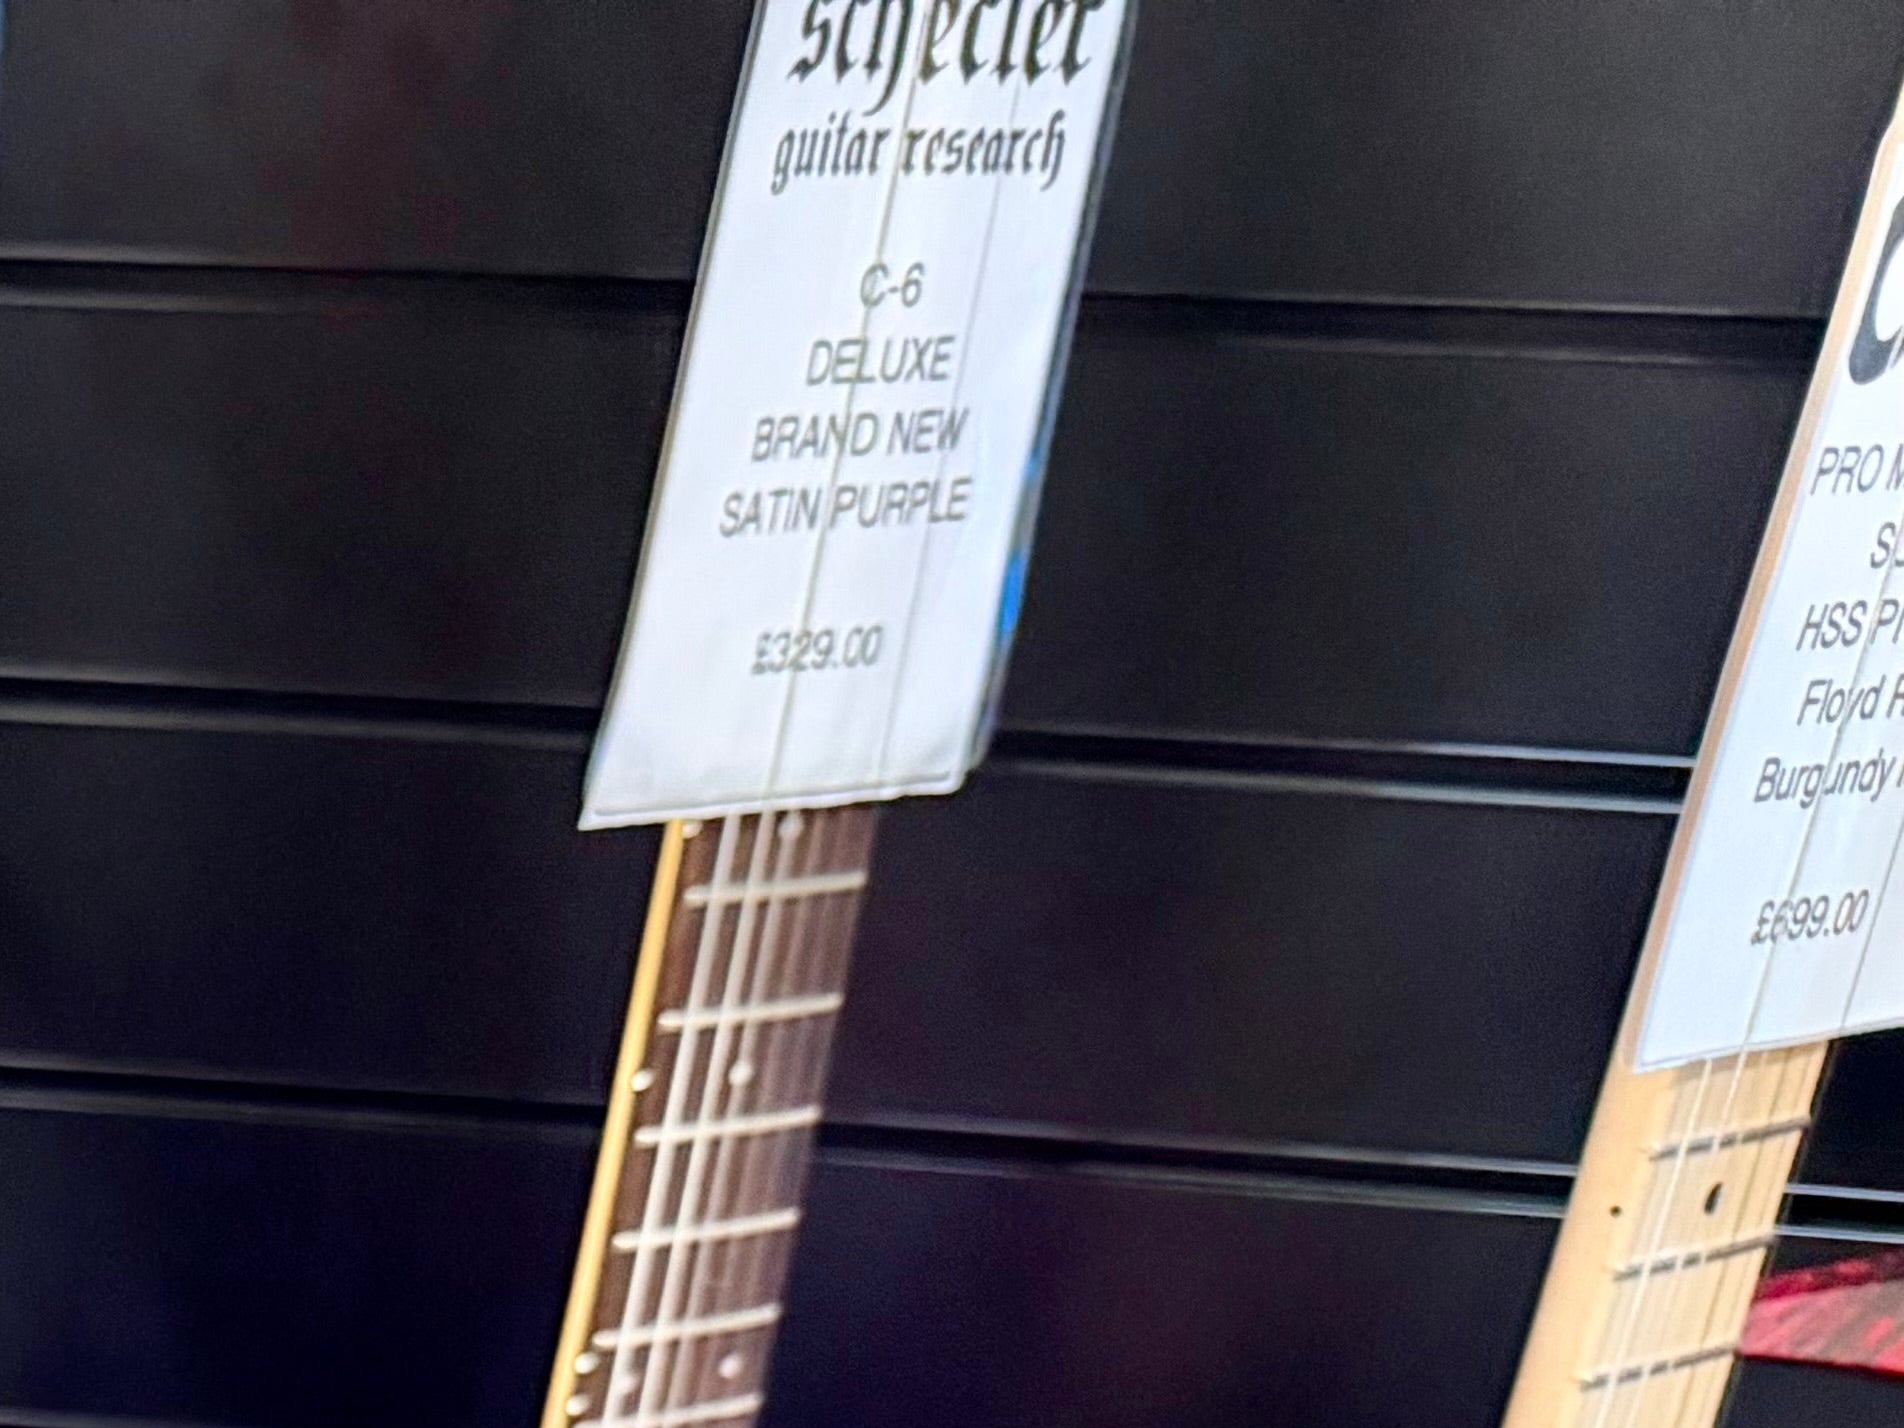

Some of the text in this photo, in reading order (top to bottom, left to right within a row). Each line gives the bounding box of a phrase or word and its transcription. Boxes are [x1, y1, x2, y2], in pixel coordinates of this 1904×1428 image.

[771, 109, 1066, 196] guitar research
[860, 262, 925, 309] C-6
[806, 335, 956, 387] DELUXE
[751, 408, 971, 464] BRAND NEW
[1809, 443, 1884, 496] PRO
[718, 477, 975, 540] SATIN PURPLE
[750, 624, 884, 677] £329.00
[1795, 600, 1868, 651] HSS
[1796, 674, 1887, 731] Floyd
[1753, 747, 1898, 810] Burgundy
[1750, 888, 1871, 947] £699.00
